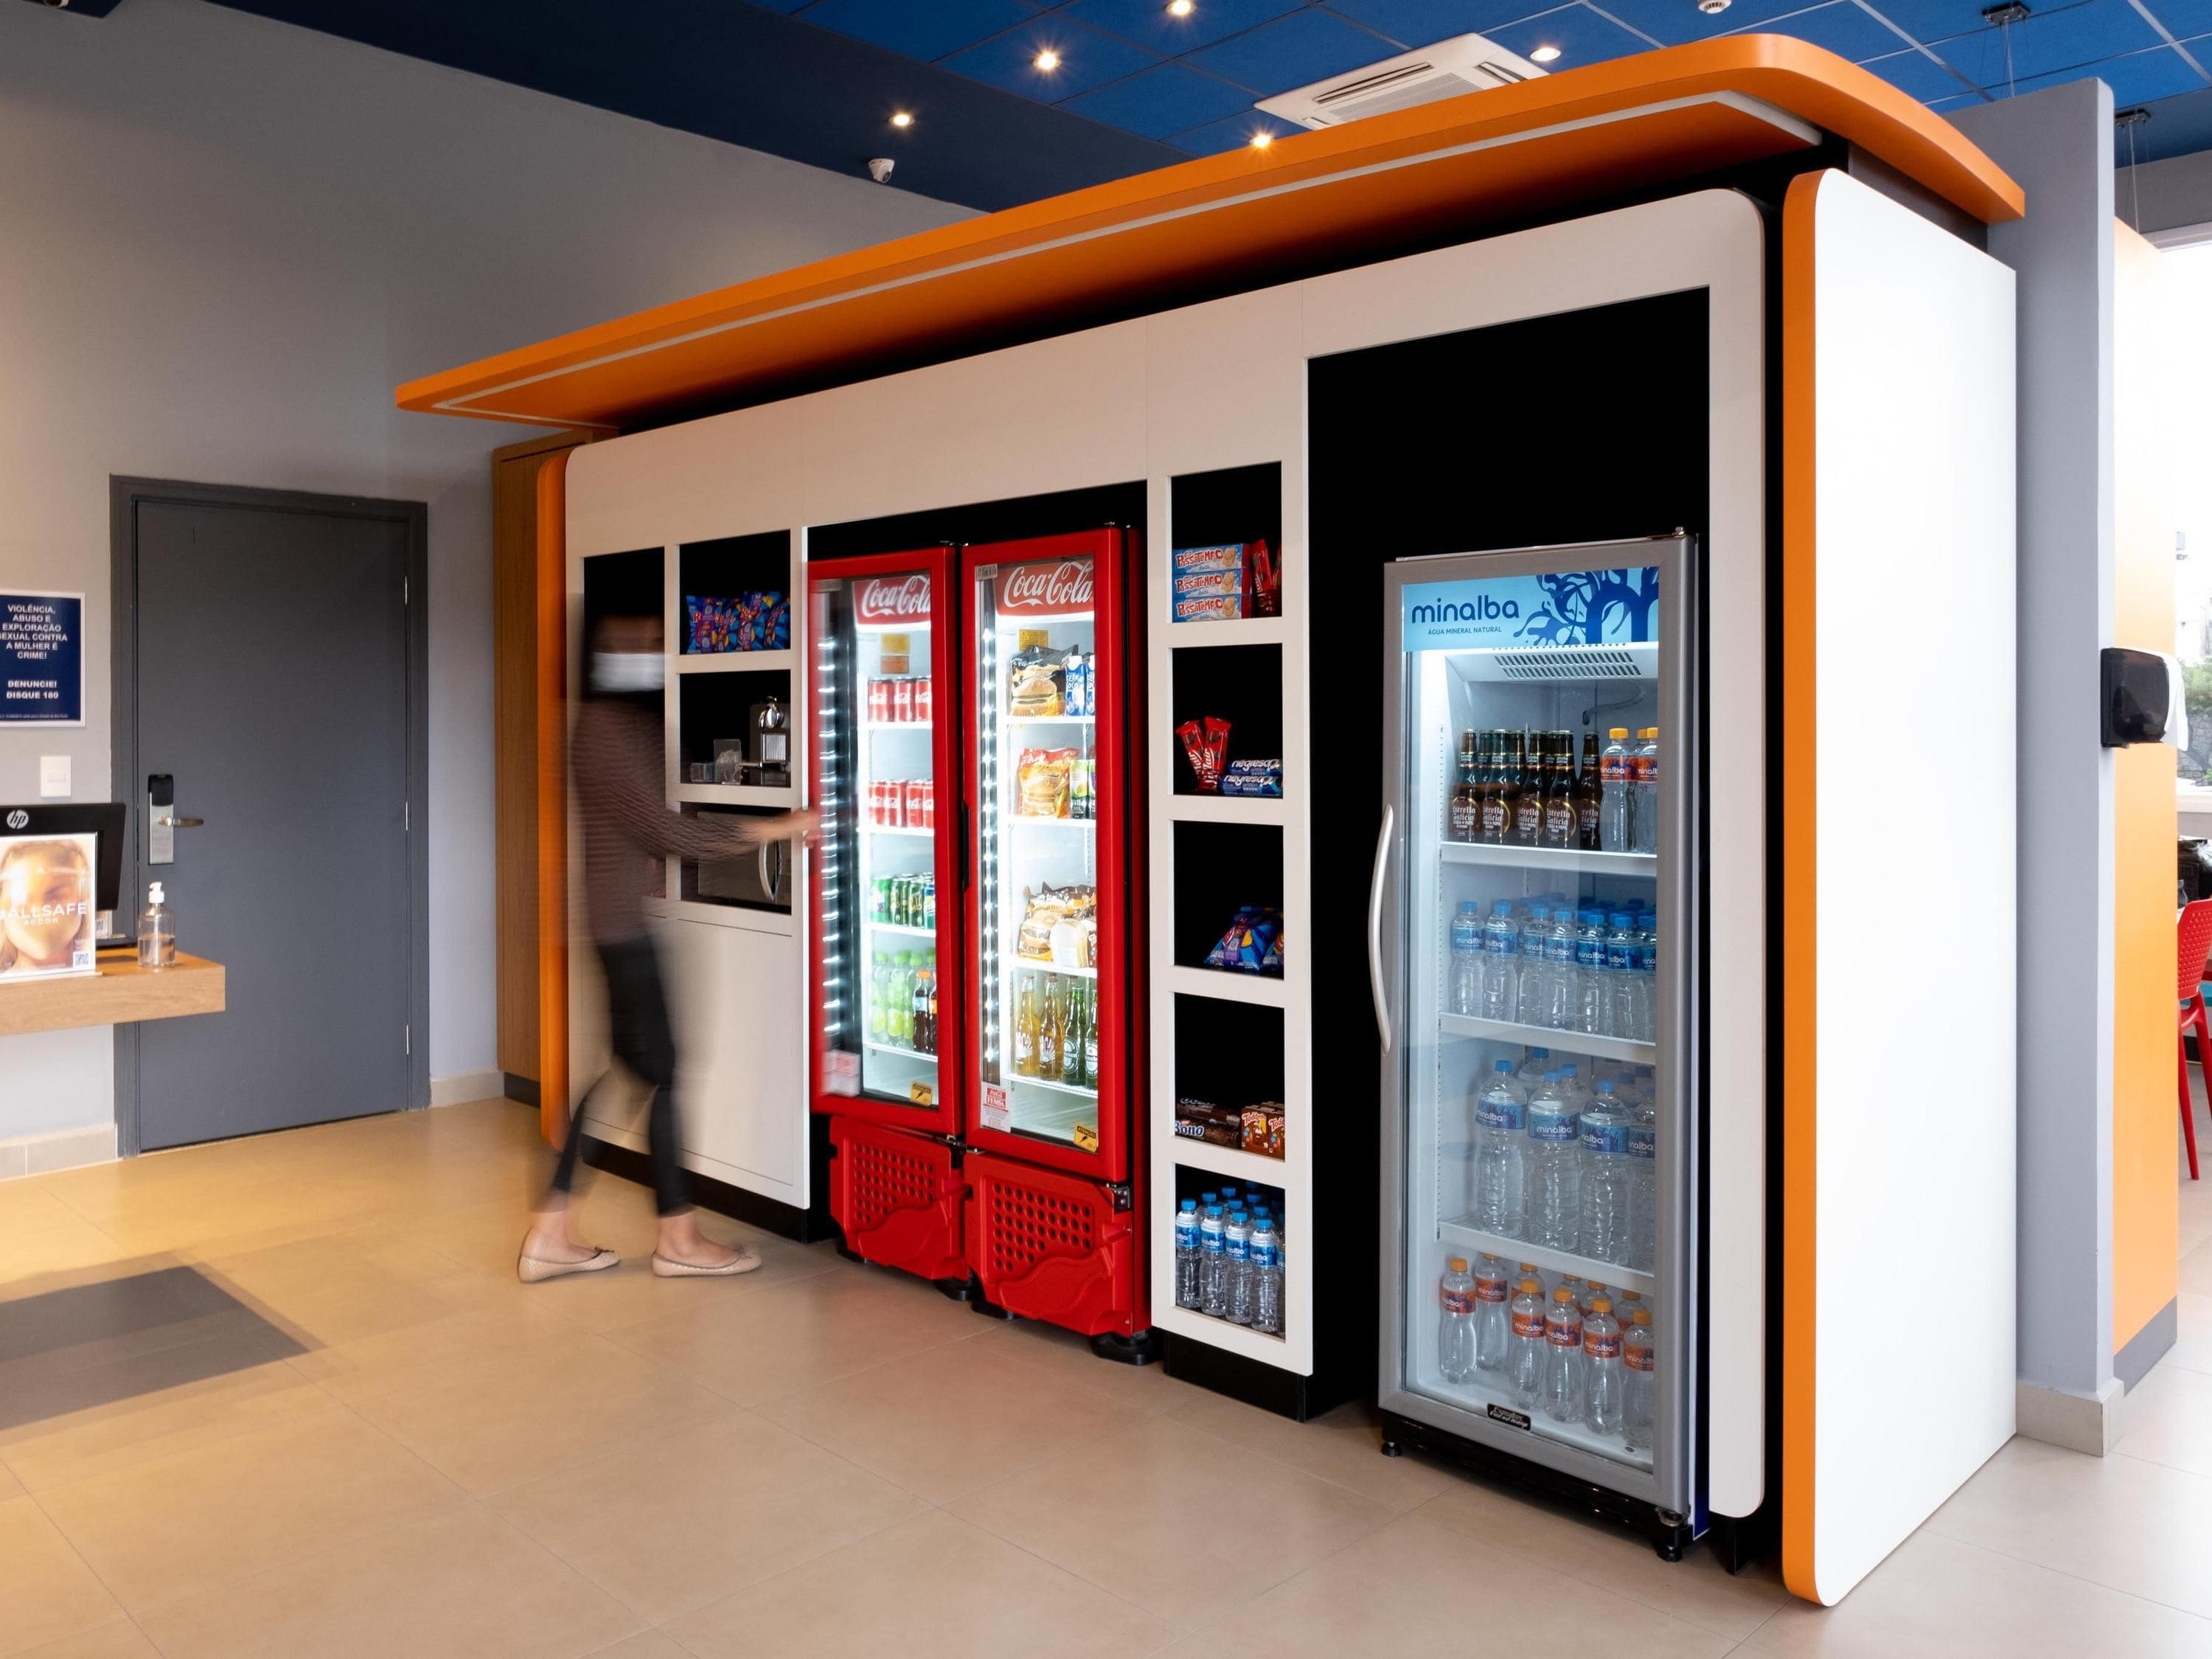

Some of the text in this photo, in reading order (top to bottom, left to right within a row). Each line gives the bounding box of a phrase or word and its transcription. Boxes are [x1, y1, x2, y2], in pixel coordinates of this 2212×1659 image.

[1004, 561, 1093, 608] Coca-Cola
[7, 603, 56, 614] VIOLÊNCIA,
[1411, 594, 1520, 623] minalba
[13, 614, 44, 622] ABUSO
[2, 622, 61, 632] EXPLORAÇÃO
[1427, 627, 1444, 636] ÁGUA
[0, 632, 68, 641] EXUAL CONTRA
[6, 640, 58, 650] A MULHER É
[17, 650, 47, 659] CRIME!
[7, 680, 58, 688] DENUNCIE!
[6, 691, 59, 700] DISQUE 180
[9, 810, 27, 830] hp
[1537, 1126, 1572, 1134] minalba
[1514, 1322, 1543, 1332] minalba
